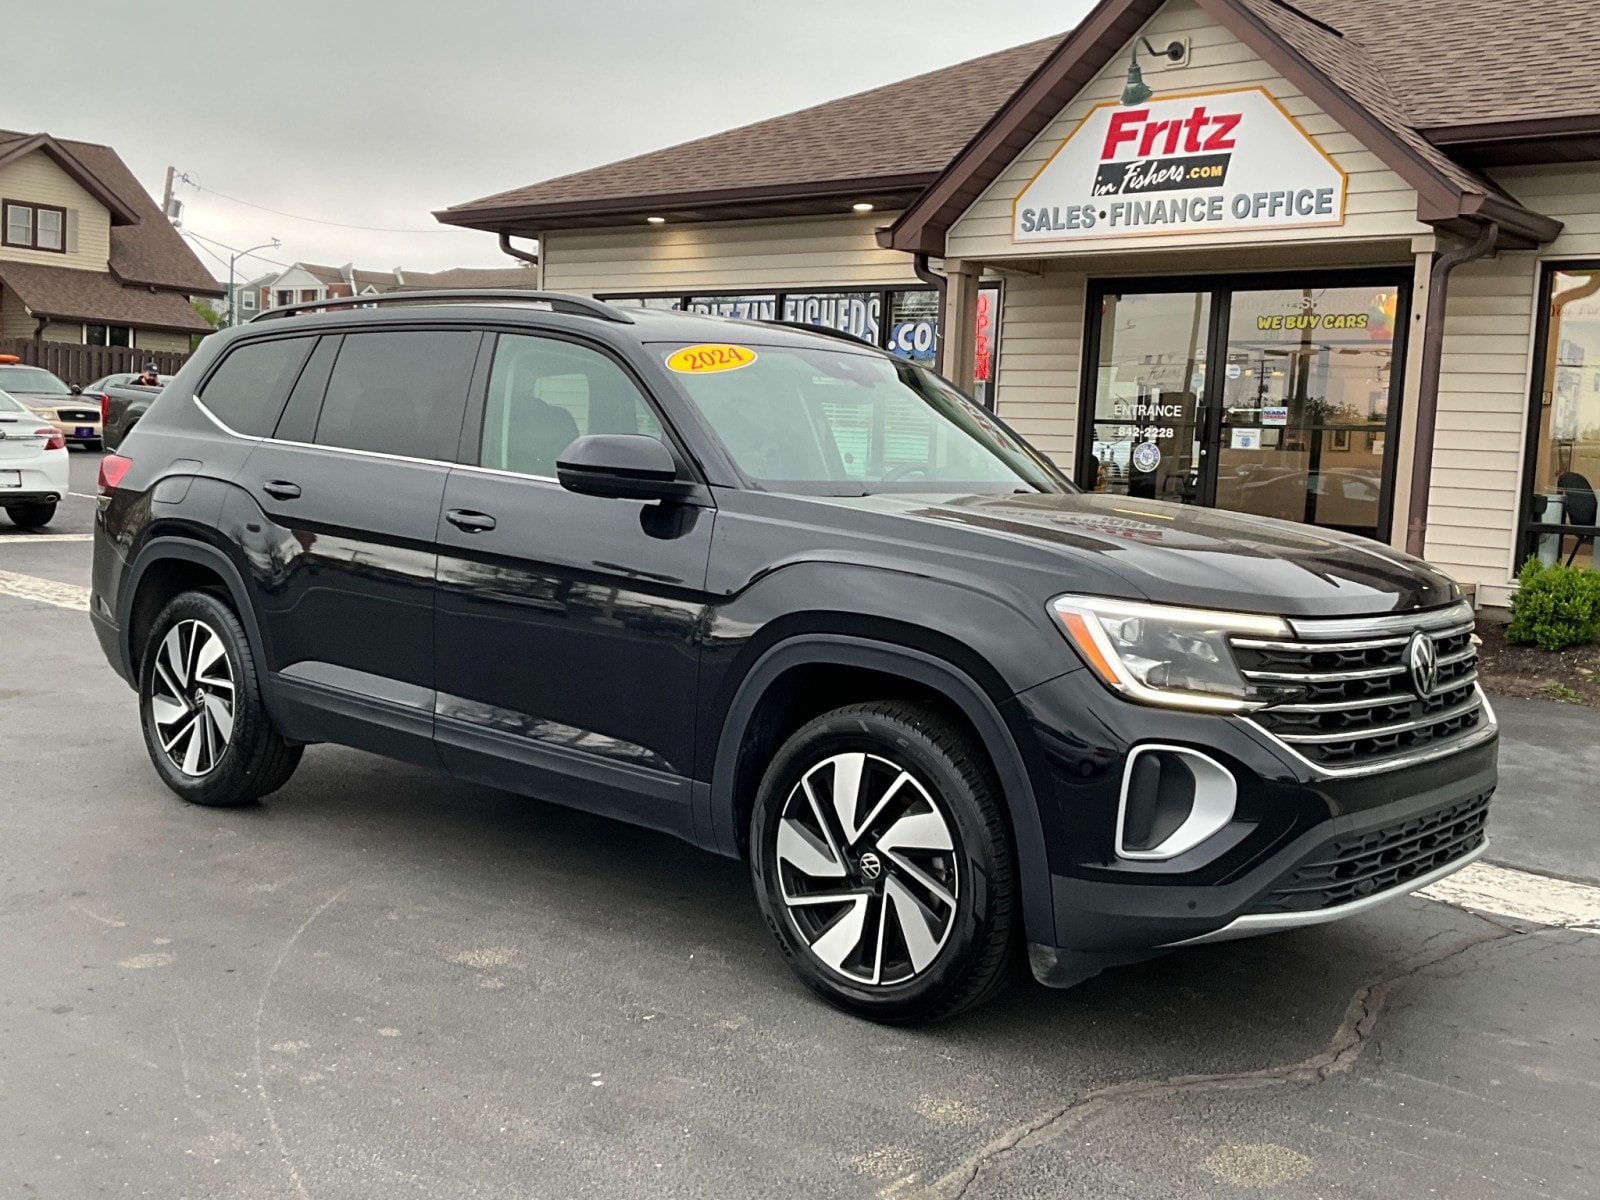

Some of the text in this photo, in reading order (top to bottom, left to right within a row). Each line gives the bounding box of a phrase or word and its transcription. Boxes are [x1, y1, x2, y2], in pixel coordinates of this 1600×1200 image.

[1100, 105, 1243, 161] Fritz
[1093, 175, 1118, 196] in
[1231, 187, 1334, 220] OFFICE
[1257, 313, 1369, 330] WE BUY CARS
[888, 321, 939, 353] .CO
[975, 293, 989, 380] OPEN
[683, 347, 744, 370] 2024
[1113, 404, 1182, 417] ENTRANCE
[1117, 427, 1175, 438] 842-2228
